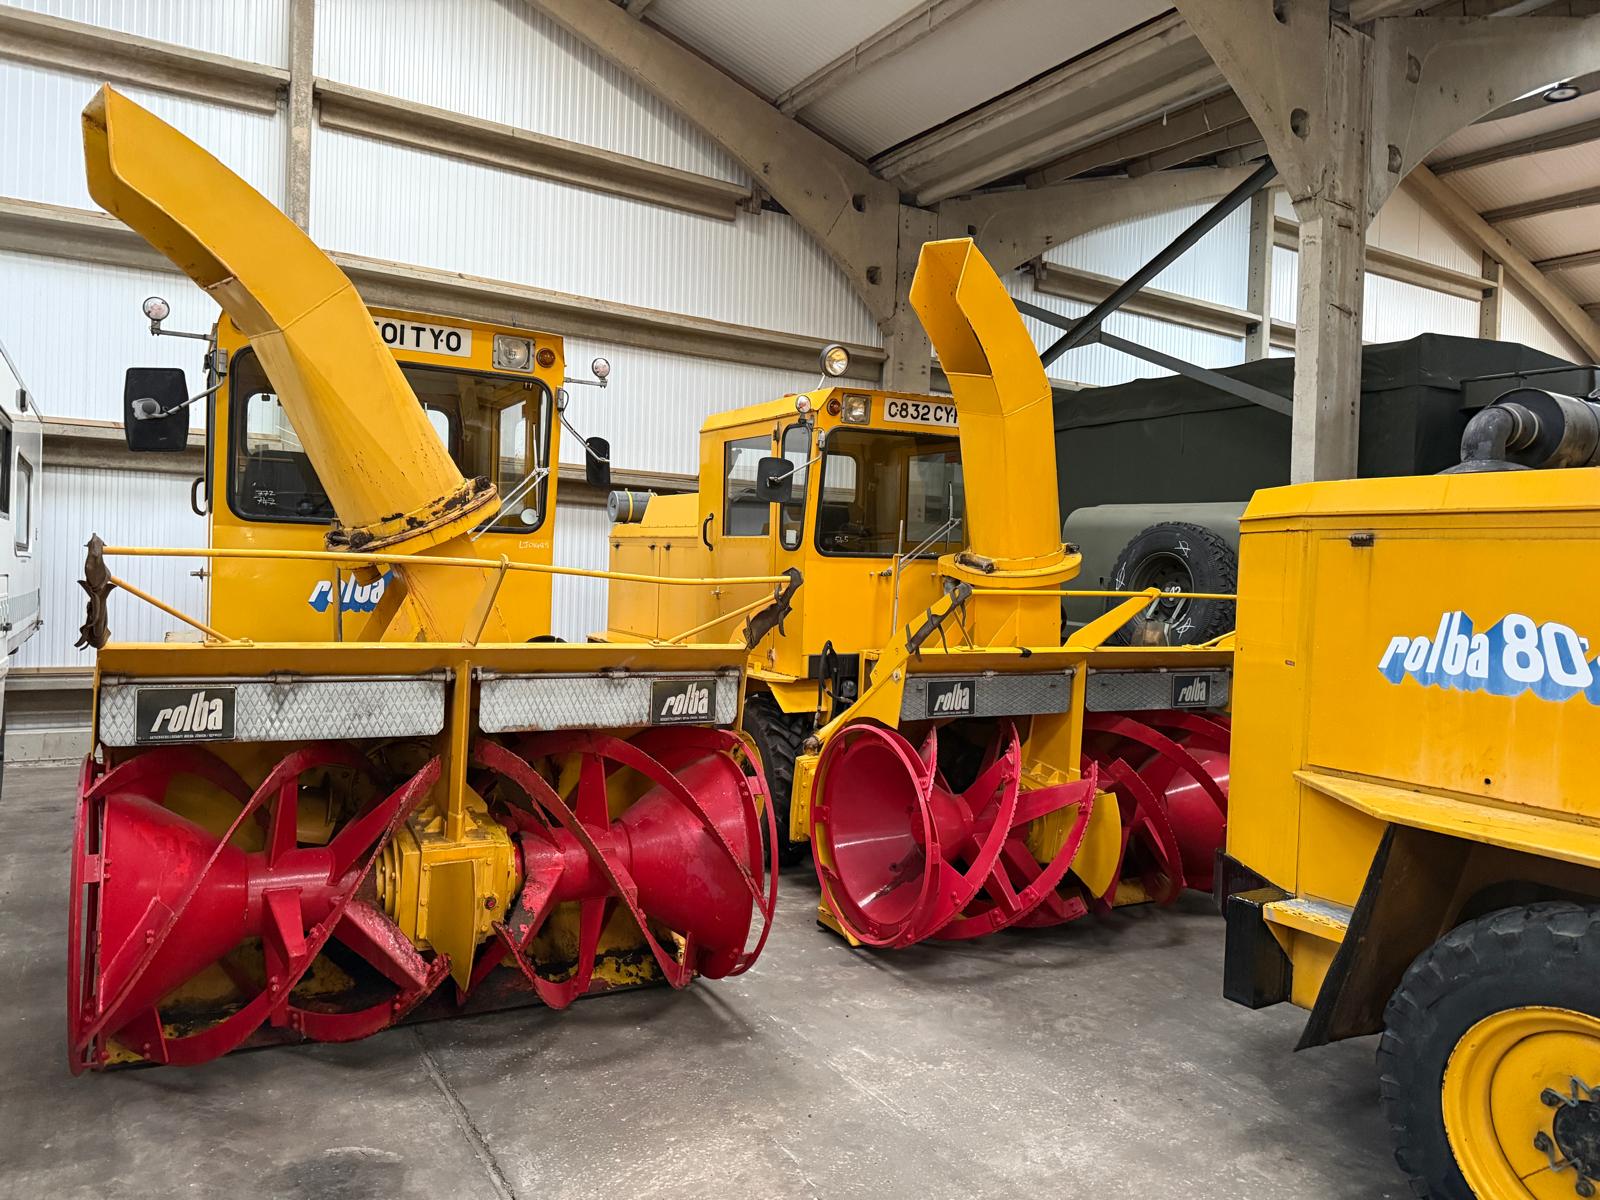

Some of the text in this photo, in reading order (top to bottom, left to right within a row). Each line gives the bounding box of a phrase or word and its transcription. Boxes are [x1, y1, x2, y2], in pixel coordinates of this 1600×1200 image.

[374, 321, 405, 348] 01
[888, 401, 931, 421] C832
[1378, 610, 1490, 679] rolba
[660, 682, 709, 716] rolba
[933, 682, 970, 711] rolba
[1178, 676, 1206, 702] rolba
[150, 690, 223, 733] rolba
